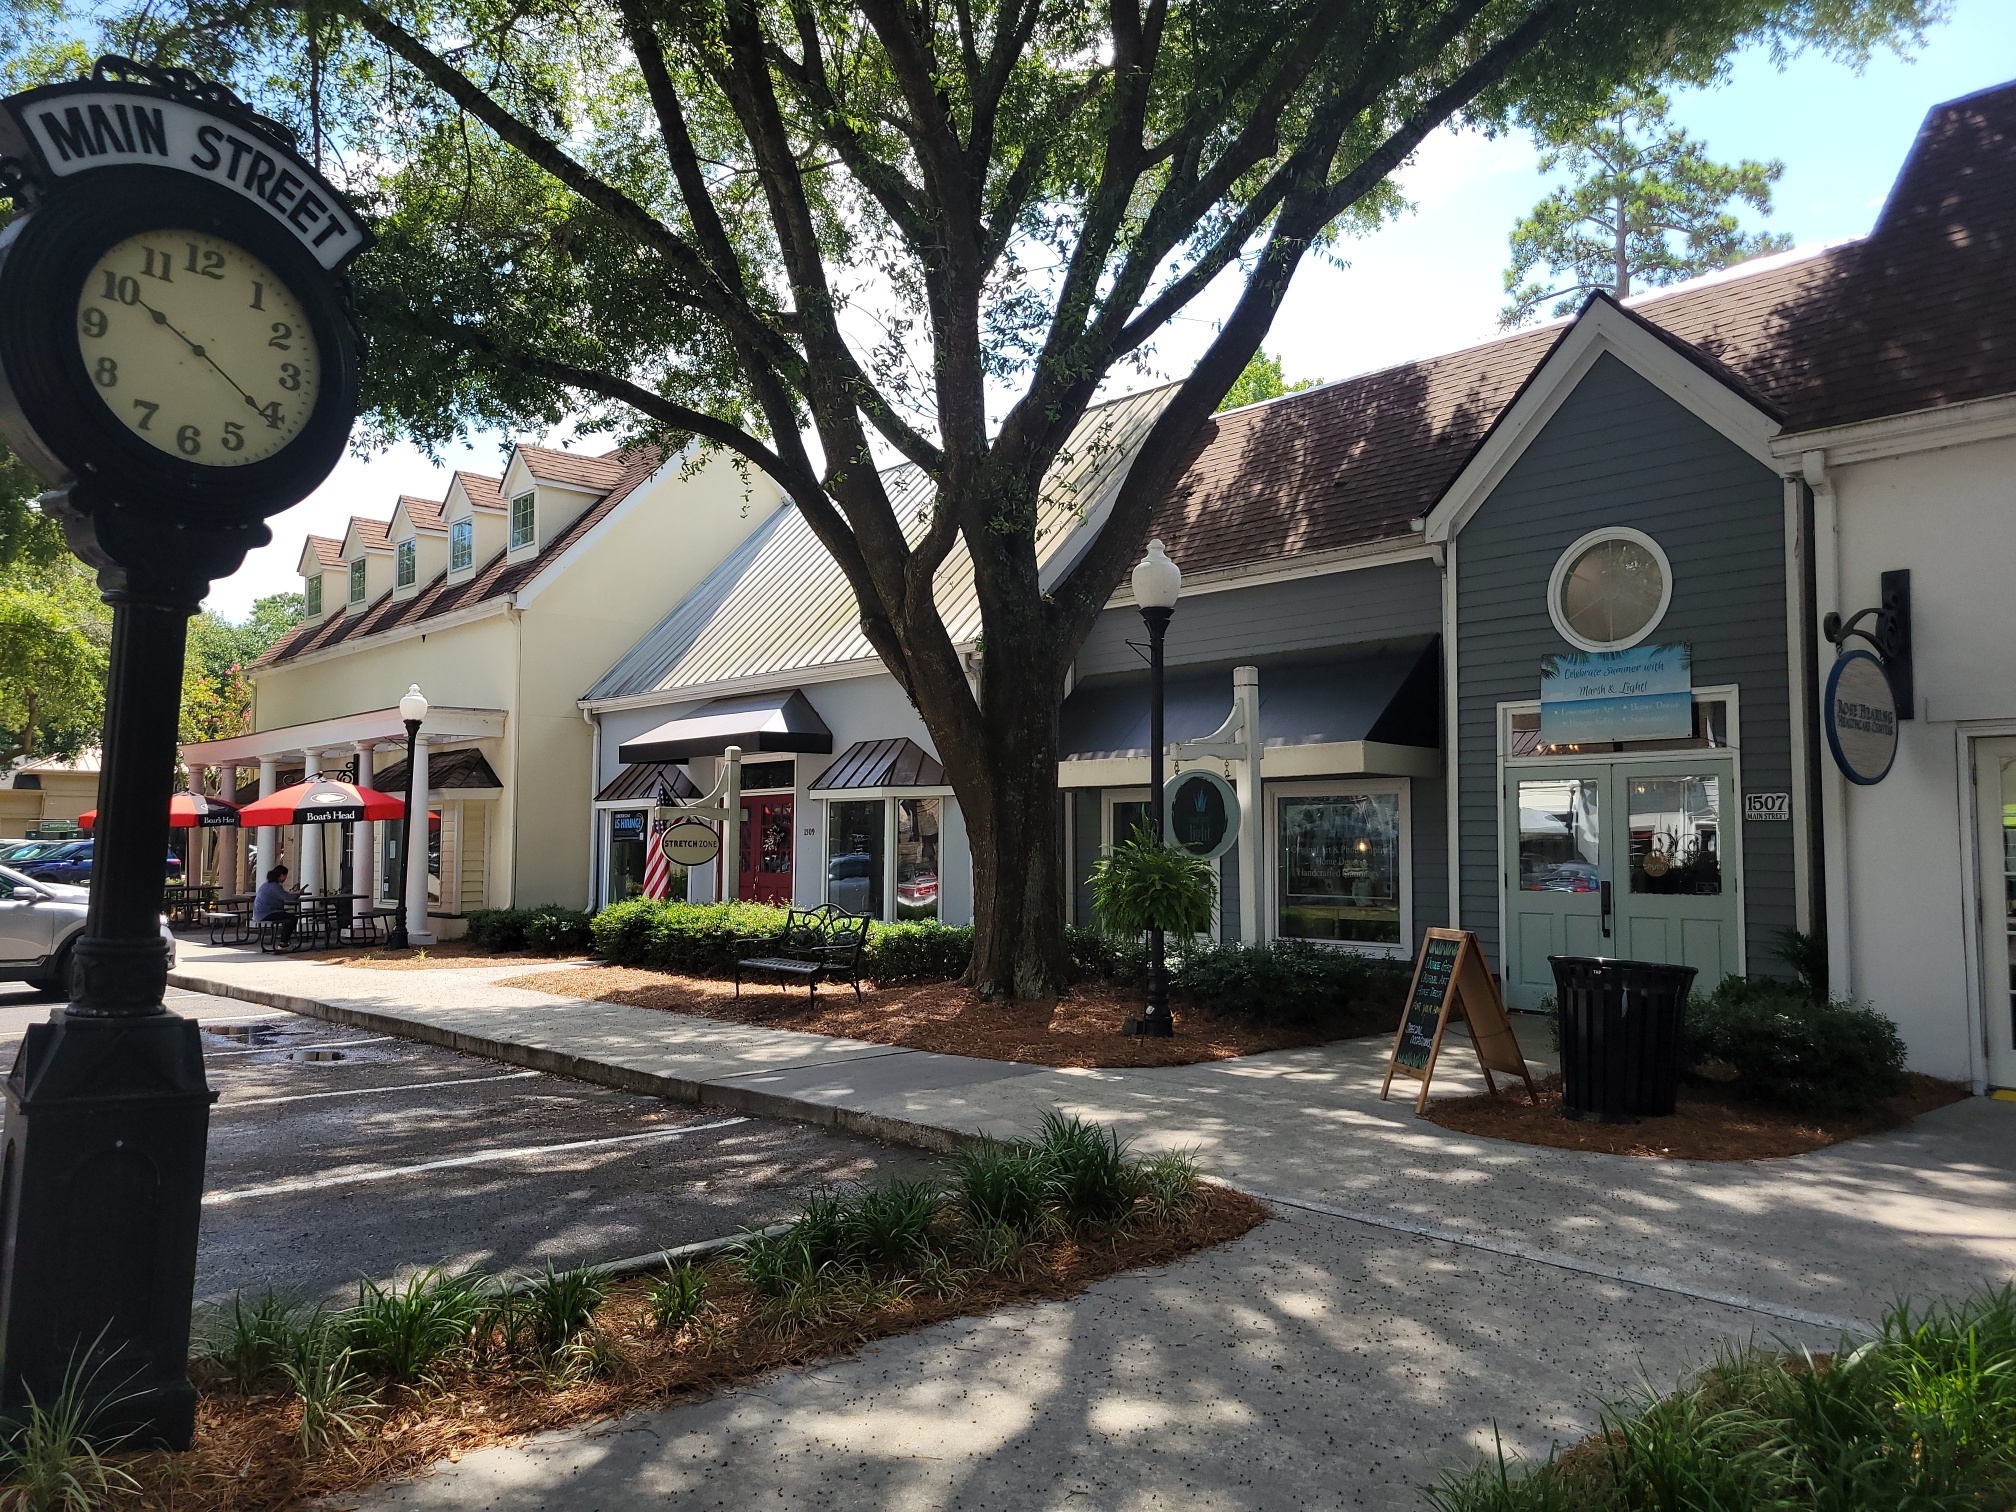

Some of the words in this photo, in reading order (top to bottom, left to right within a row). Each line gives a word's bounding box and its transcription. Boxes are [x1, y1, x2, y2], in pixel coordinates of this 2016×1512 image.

[39, 104, 169, 163] MAIN
[191, 125, 348, 249] STREET
[140, 247, 174, 284] 11
[185, 242, 225, 280] 12
[100, 270, 141, 306] 10
[249, 281, 266, 311] 1
[82, 308, 109, 338] 9
[268, 322, 292, 350] 2
[95, 357, 118, 388] 8
[279, 363, 302, 391] 3
[133, 399, 160, 431] 7
[259, 402, 285, 430] 4
[176, 424, 201, 455] 6
[221, 421, 245, 451] 5
[1564, 667, 1602, 680] Celebrate
[1603, 665, 1641, 677] Summer
[1644, 661, 1664, 672] with
[1578, 684, 1606, 696] Marsh
[1608, 684, 1616, 693] &
[1620, 681, 1648, 695] Light!
[306, 811, 331, 821] Boar's
[333, 810, 355, 820] Head
[1747, 795, 1787, 811] 1507
[1747, 812, 1763, 820] MAIN
[1764, 812, 1787, 820] STREET
[222, 816, 235, 824] Hea
[664, 839, 698, 848] STRETCH
[698, 840, 718, 848] ZONE
